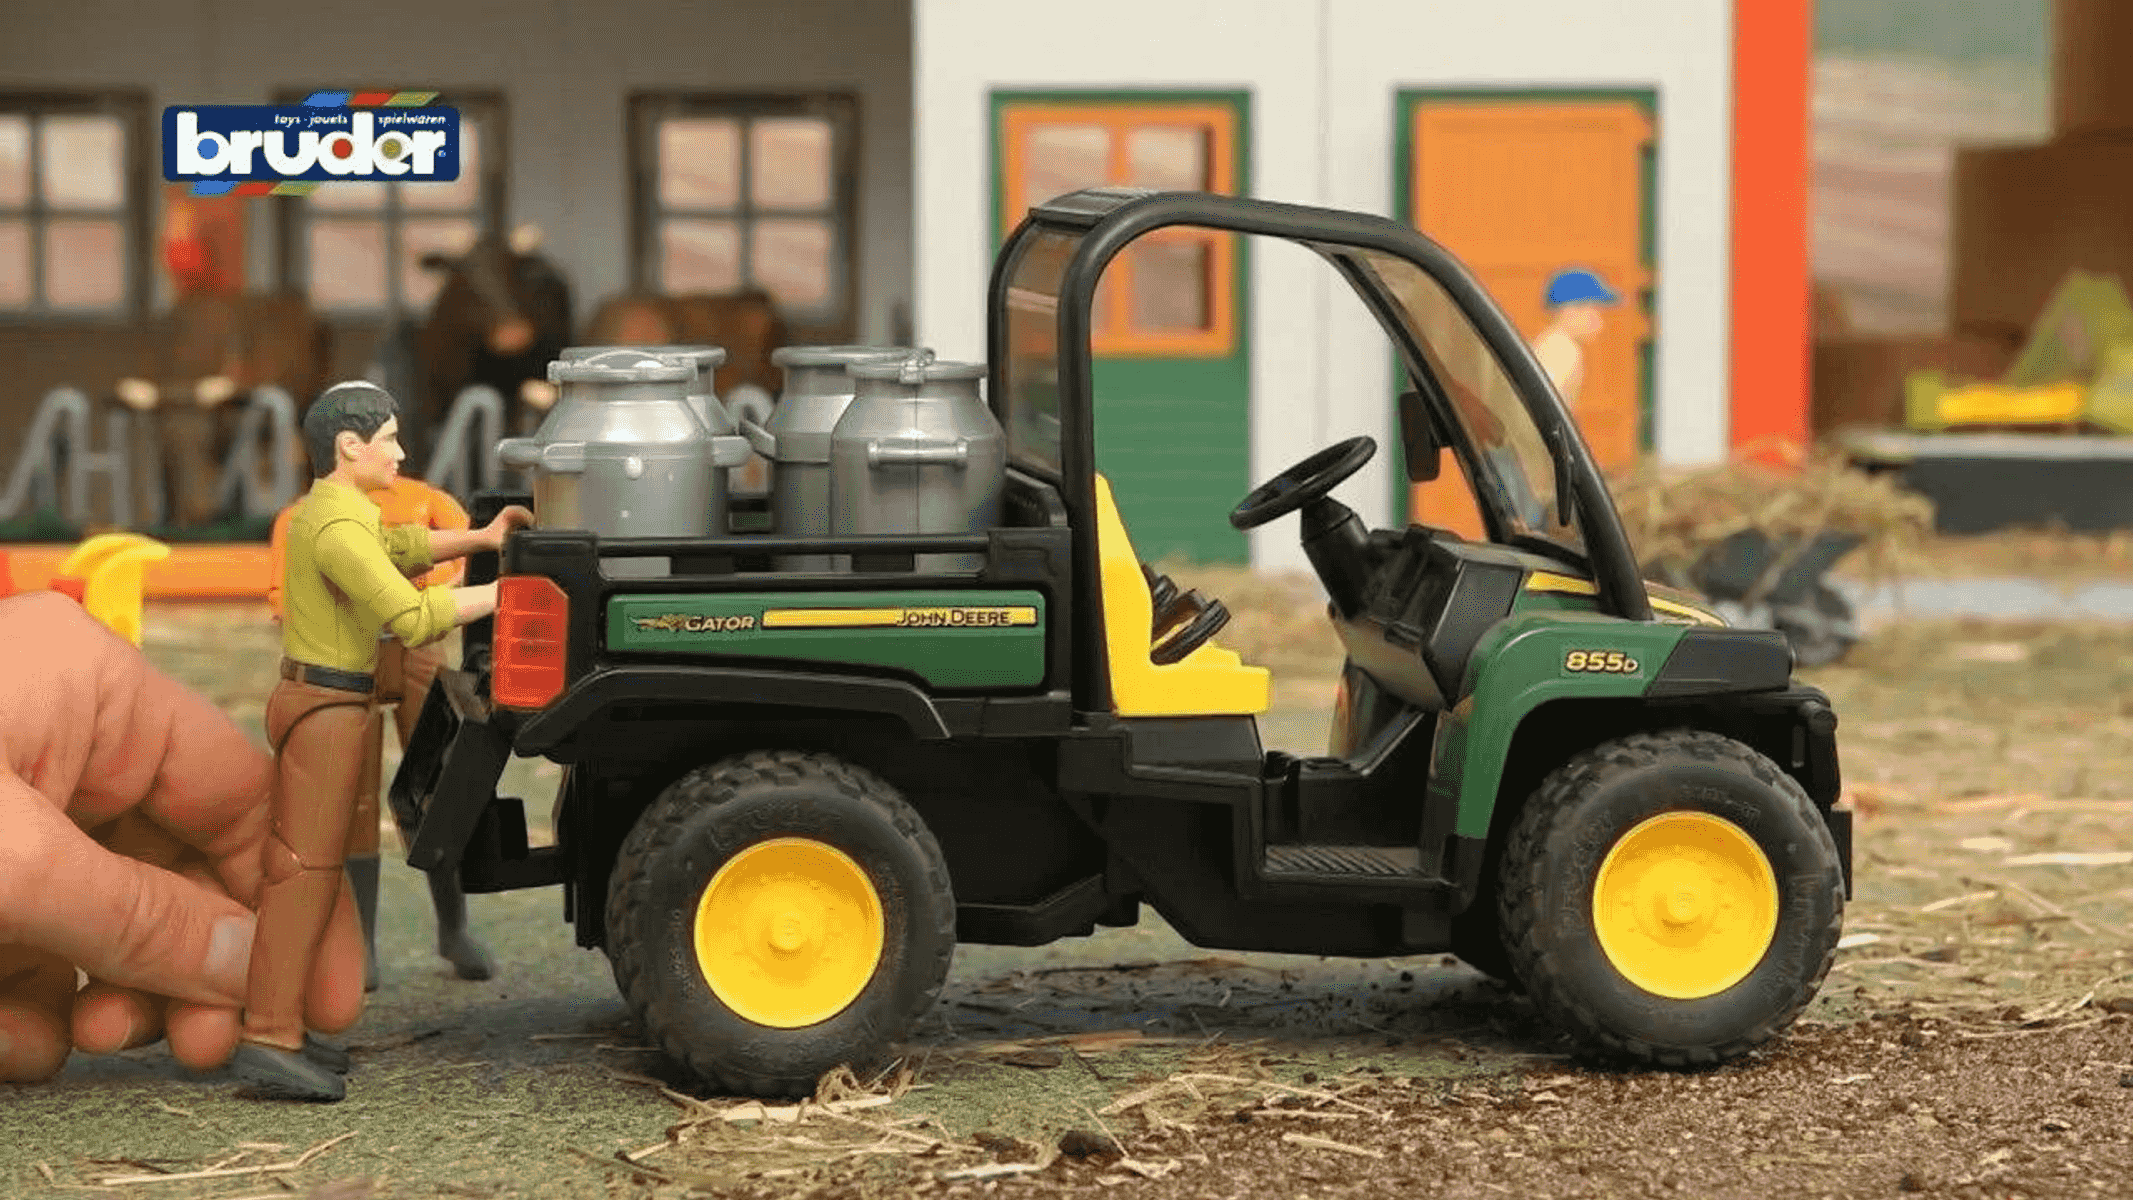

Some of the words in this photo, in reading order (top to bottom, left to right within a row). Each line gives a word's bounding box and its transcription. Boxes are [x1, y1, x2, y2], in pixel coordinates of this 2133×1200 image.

[685, 616, 755, 631] GATOR
[897, 609, 946, 626] JOHN
[951, 609, 1012, 626] DEERE
[1565, 651, 1639, 673] 855D
